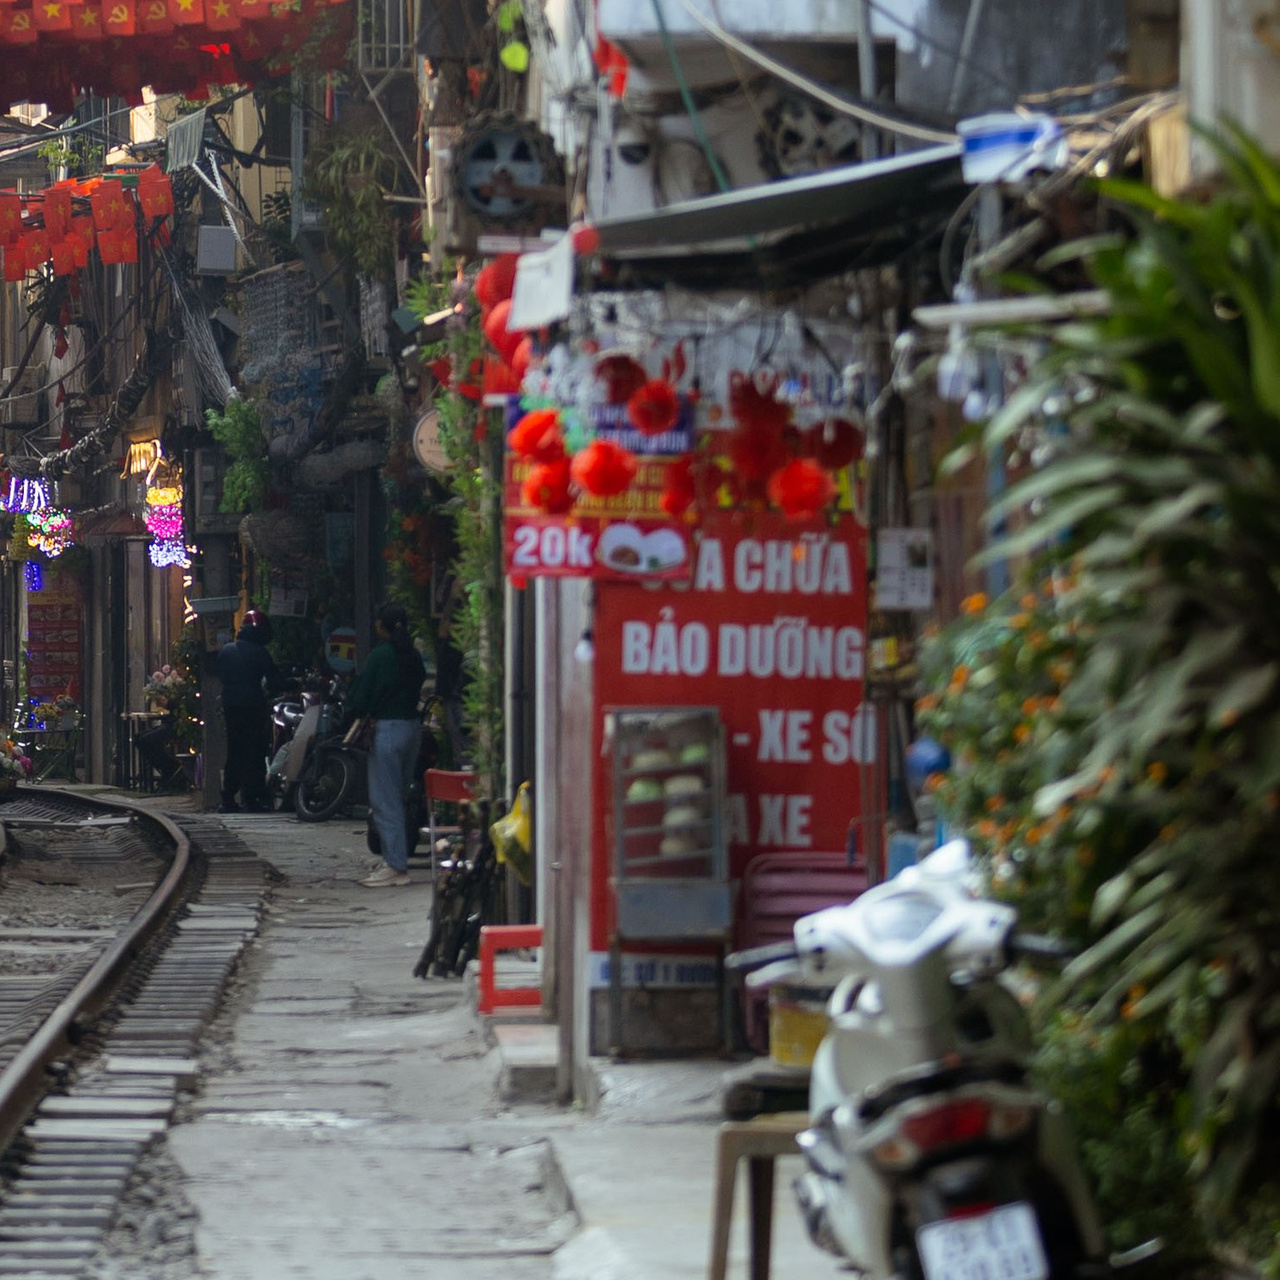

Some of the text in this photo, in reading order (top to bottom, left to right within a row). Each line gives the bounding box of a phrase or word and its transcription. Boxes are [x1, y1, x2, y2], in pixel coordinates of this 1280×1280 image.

[512, 525, 593, 567] 20k
[734, 530, 852, 594] CHỮA
[622, 606, 864, 679] BẢO DƯỠNG
[757, 709, 812, 763] XE
[757, 794, 812, 847] XE
